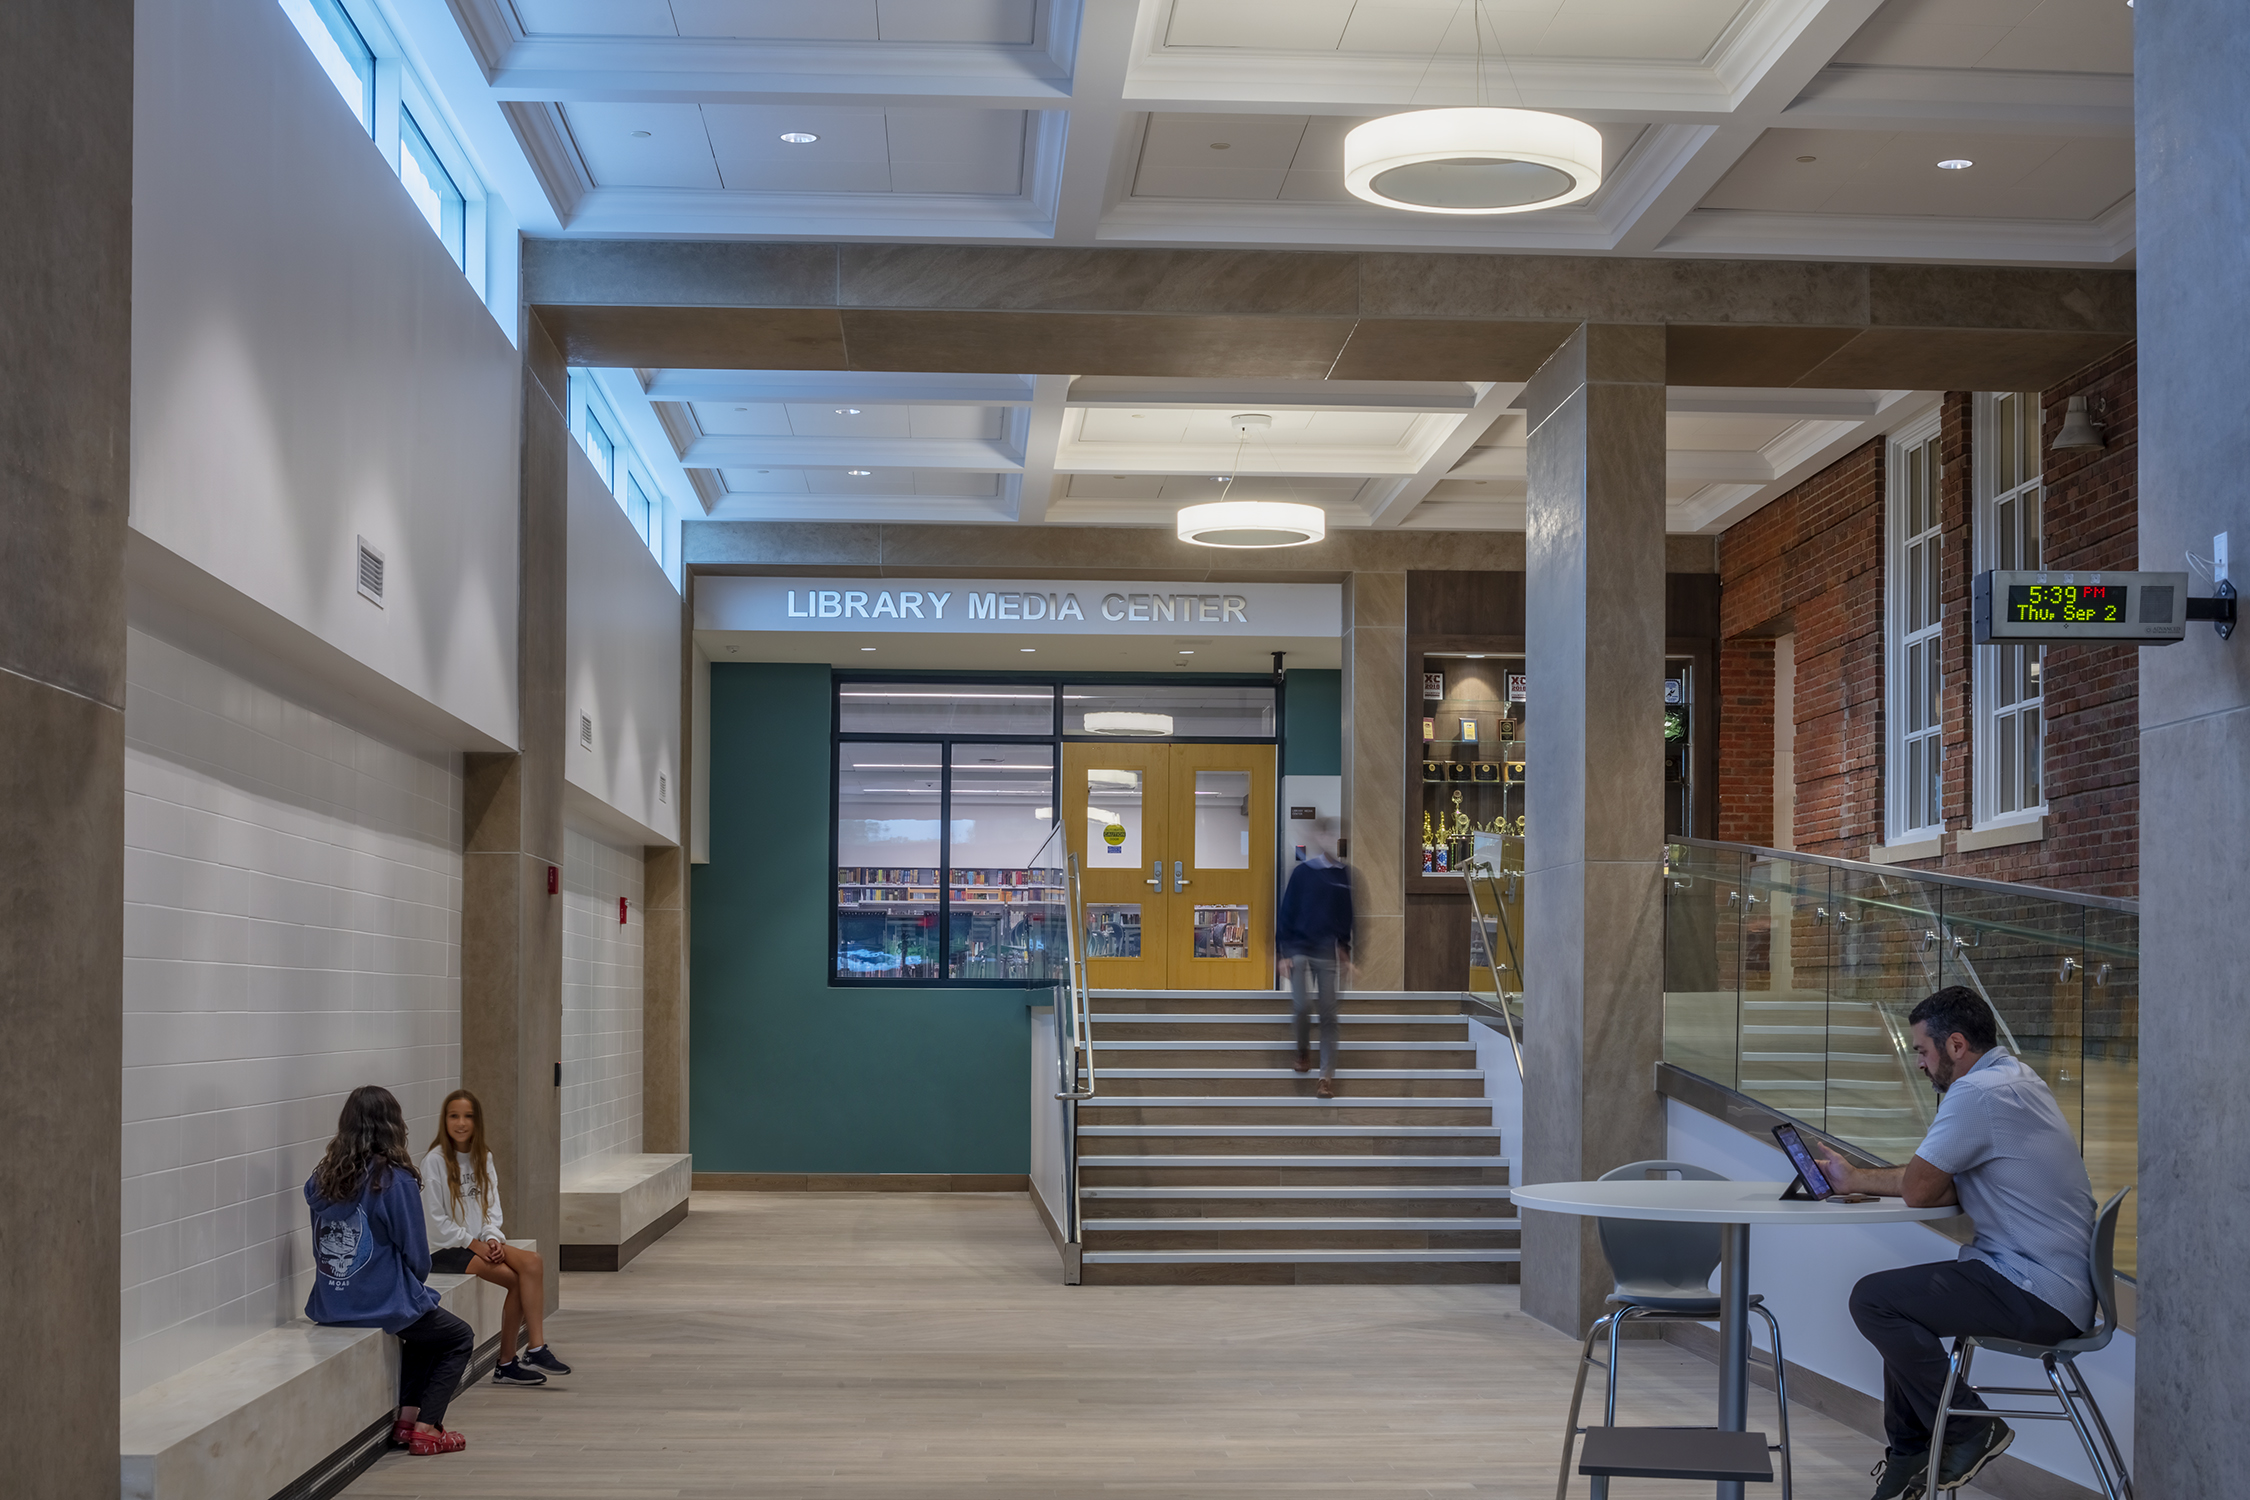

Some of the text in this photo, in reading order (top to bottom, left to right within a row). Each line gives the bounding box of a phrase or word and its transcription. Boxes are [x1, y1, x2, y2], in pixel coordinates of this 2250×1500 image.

[2029, 586, 2106, 604] 5:39 PM
[786, 589, 1249, 623] LIBRARY MEDIA CENTER
[2063, 604, 2097, 621] Sep
[2104, 605, 2117, 621] 2
[1424, 674, 1441, 683] XC
